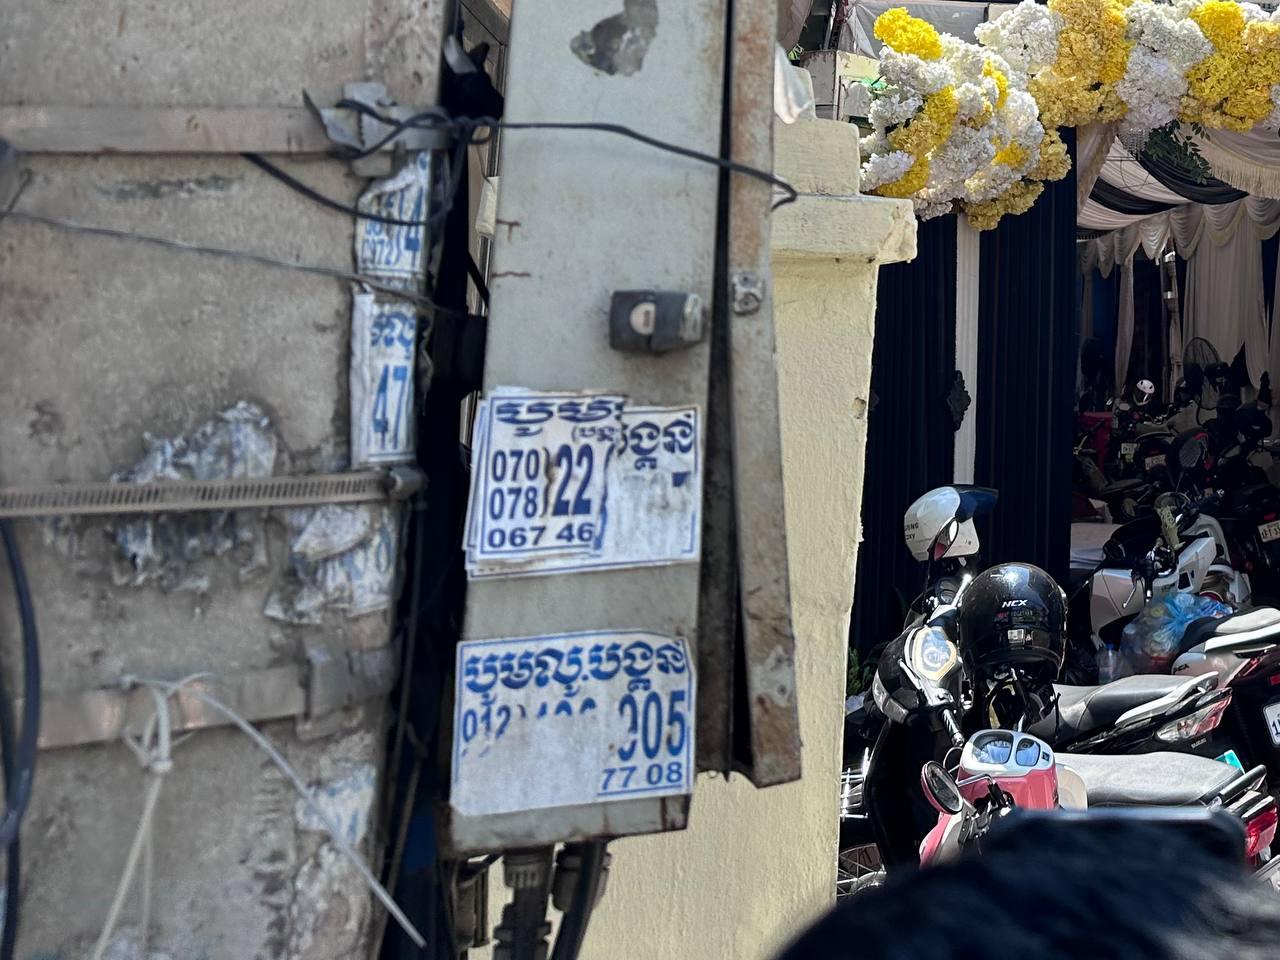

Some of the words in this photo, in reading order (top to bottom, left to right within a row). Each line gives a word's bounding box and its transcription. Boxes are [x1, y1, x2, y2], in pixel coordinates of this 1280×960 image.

[492, 449, 540, 483] 070
[552, 443, 595, 516] 22
[489, 487, 538, 520] 078
[488, 526, 546, 548] 067
[556, 523, 595, 543] 46
[1001, 599, 1028, 608] NCX
[646, 761, 683, 786] 08
